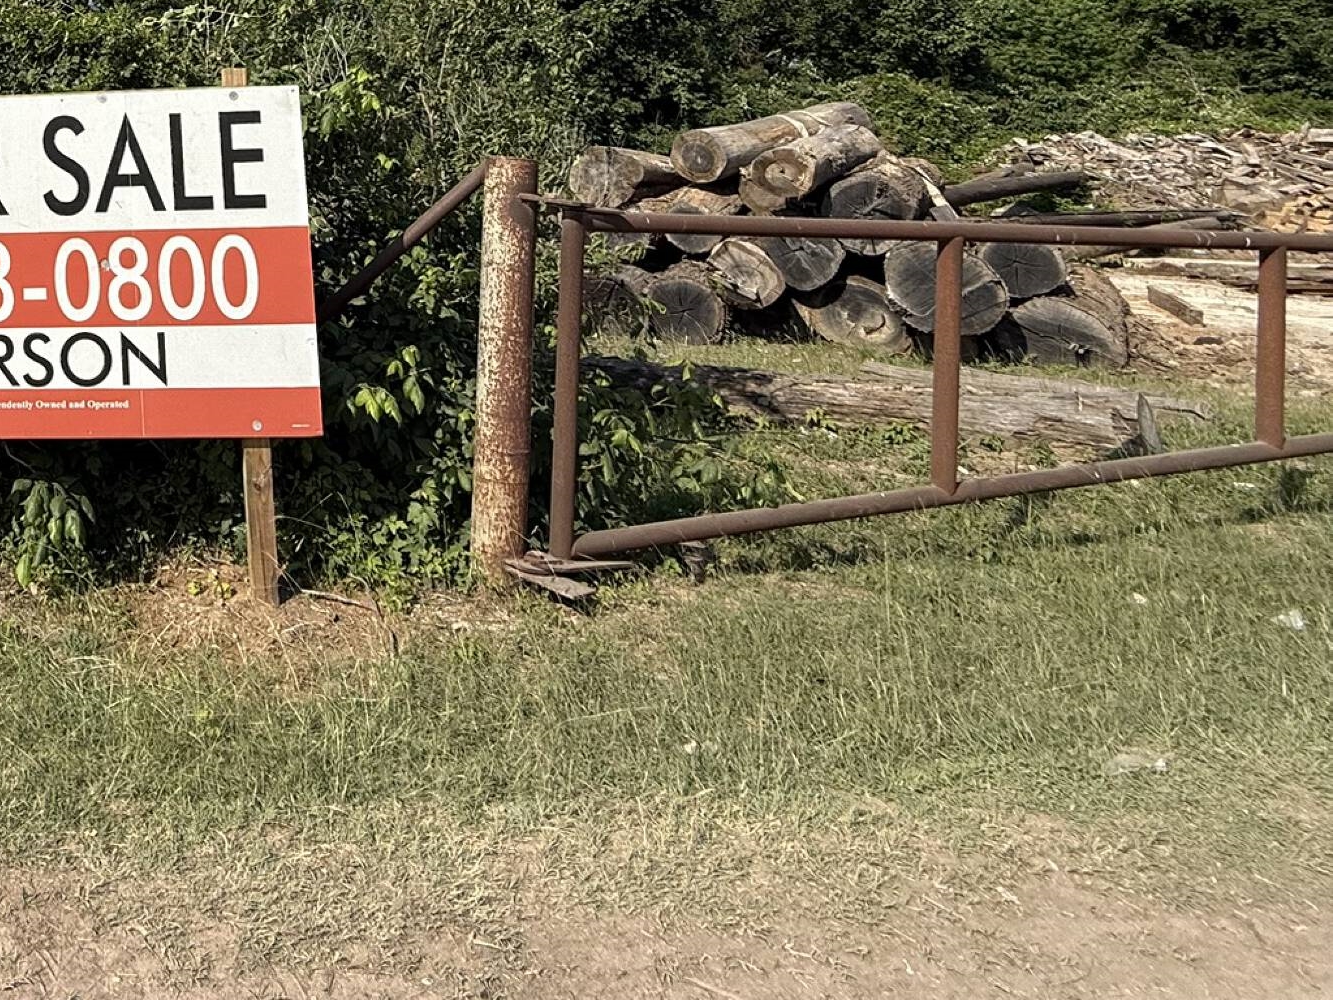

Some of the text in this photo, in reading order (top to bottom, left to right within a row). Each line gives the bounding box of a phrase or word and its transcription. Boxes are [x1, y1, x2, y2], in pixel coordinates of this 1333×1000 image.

[42, 111, 267, 216] SALE
[36, 400, 66, 409] Owned
[69, 400, 85, 409] and
[87, 400, 129, 411] Operated
